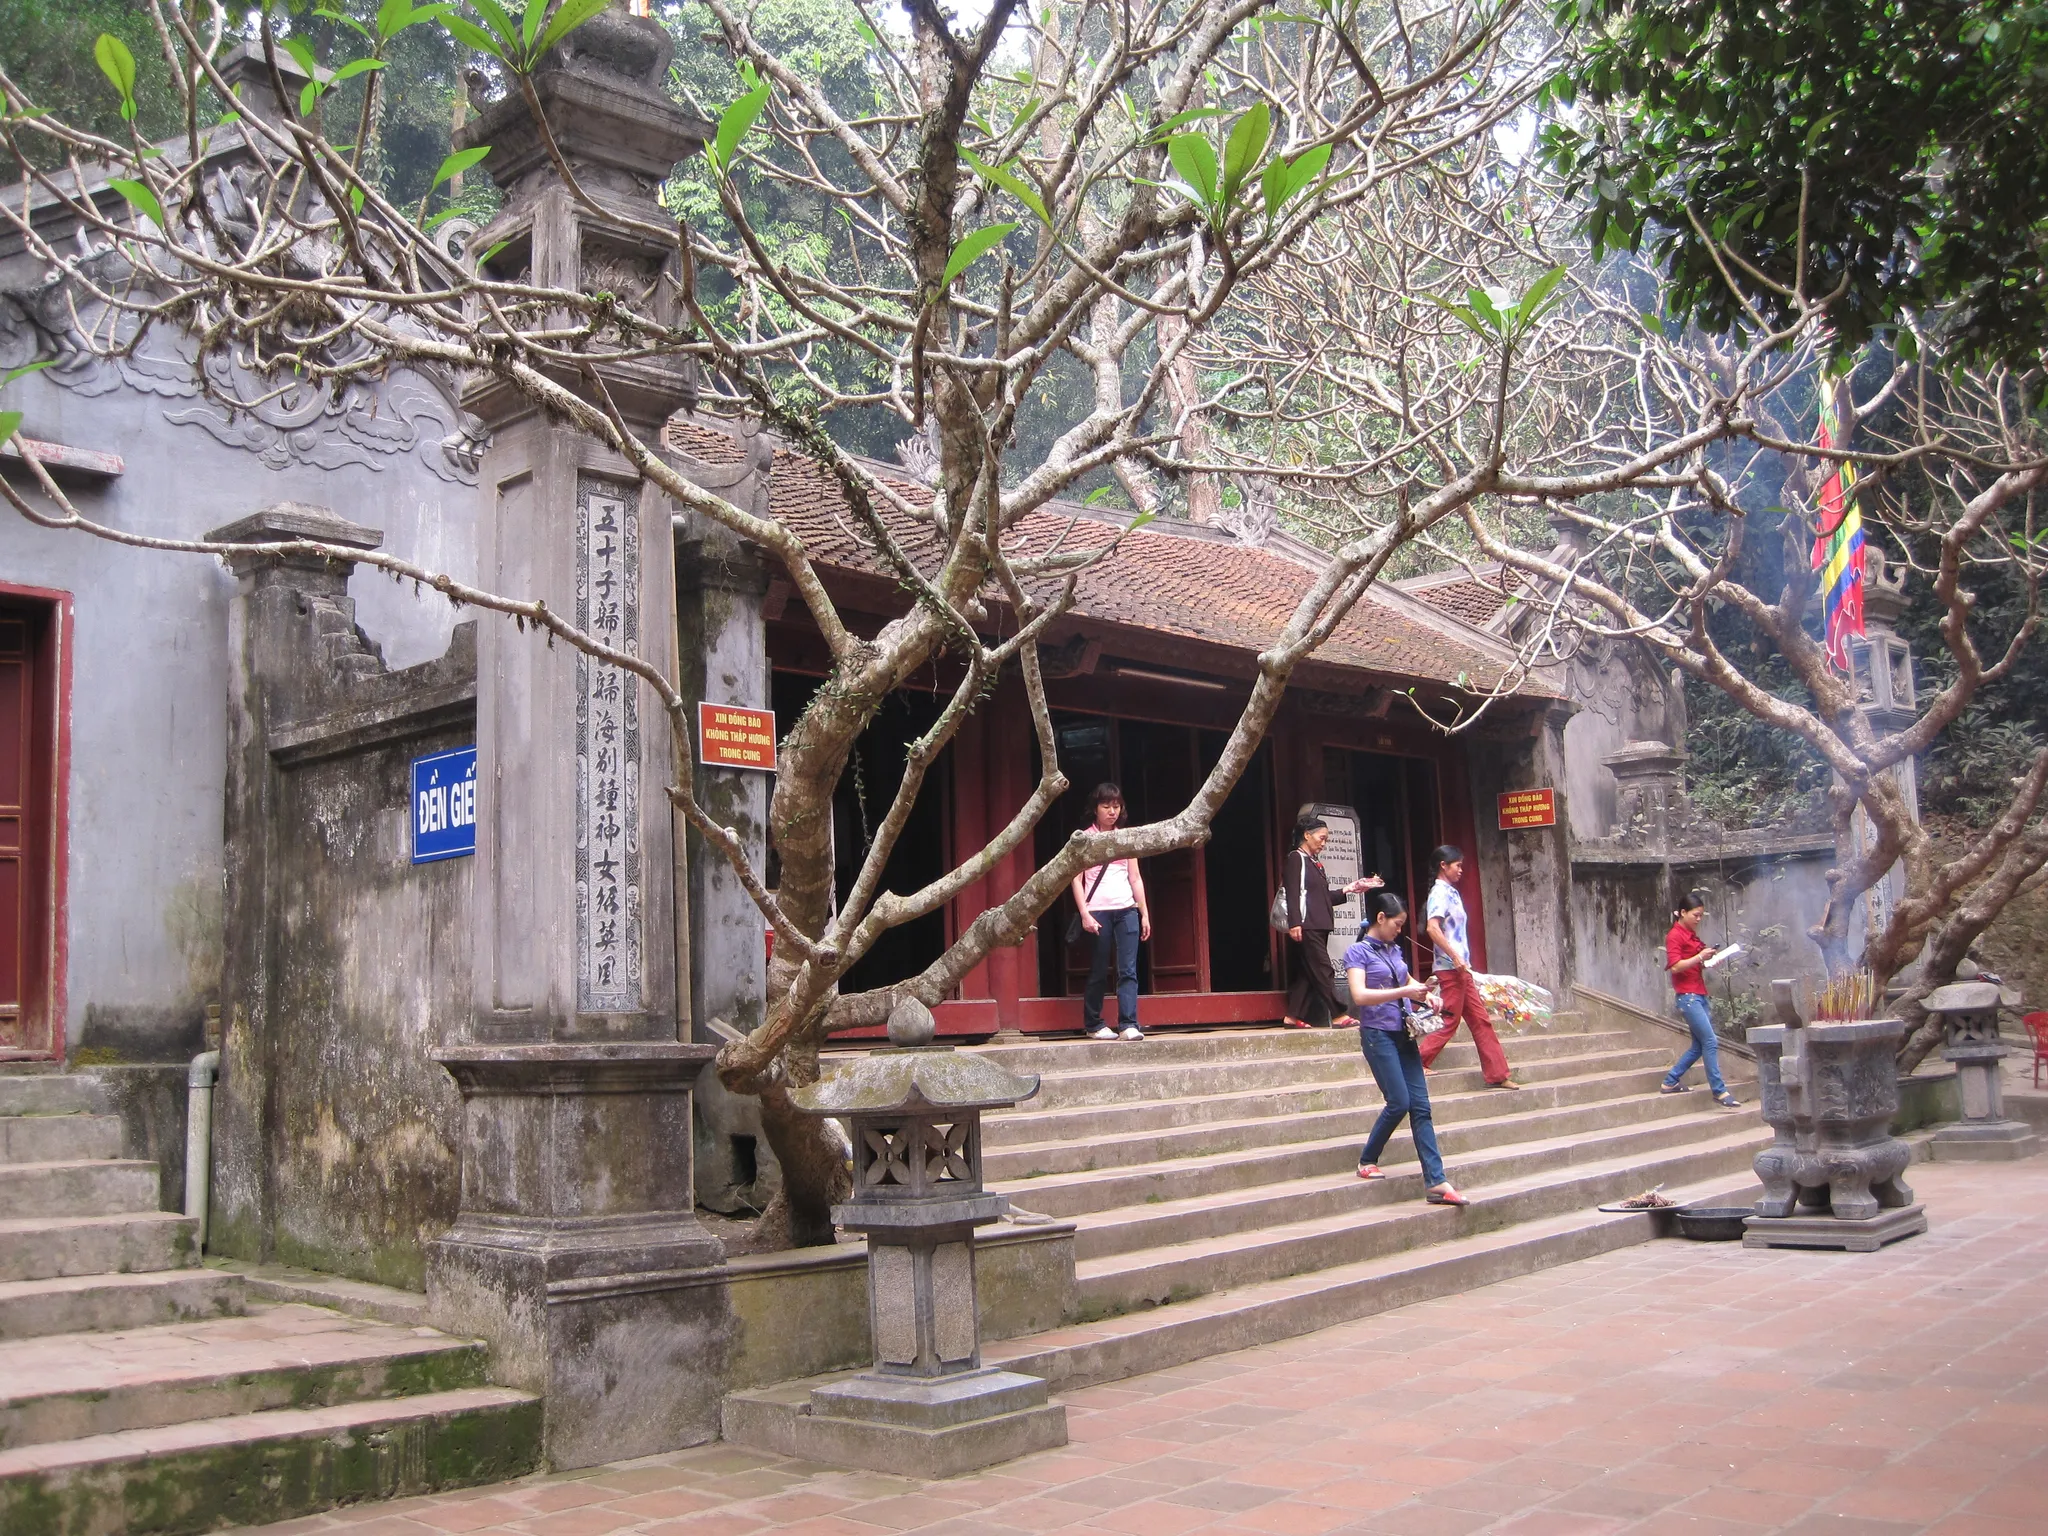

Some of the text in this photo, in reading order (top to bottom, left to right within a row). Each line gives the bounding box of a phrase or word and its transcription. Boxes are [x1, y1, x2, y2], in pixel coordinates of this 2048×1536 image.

[715, 712, 727, 724] XIN
[706, 727, 728, 741] KHÔNG
[719, 747, 761, 761] TRONG CUNG
[419, 768, 447, 834] ĐỀN
[1508, 796, 1517, 804] XIN
[1512, 816, 1528, 824] TRONG
